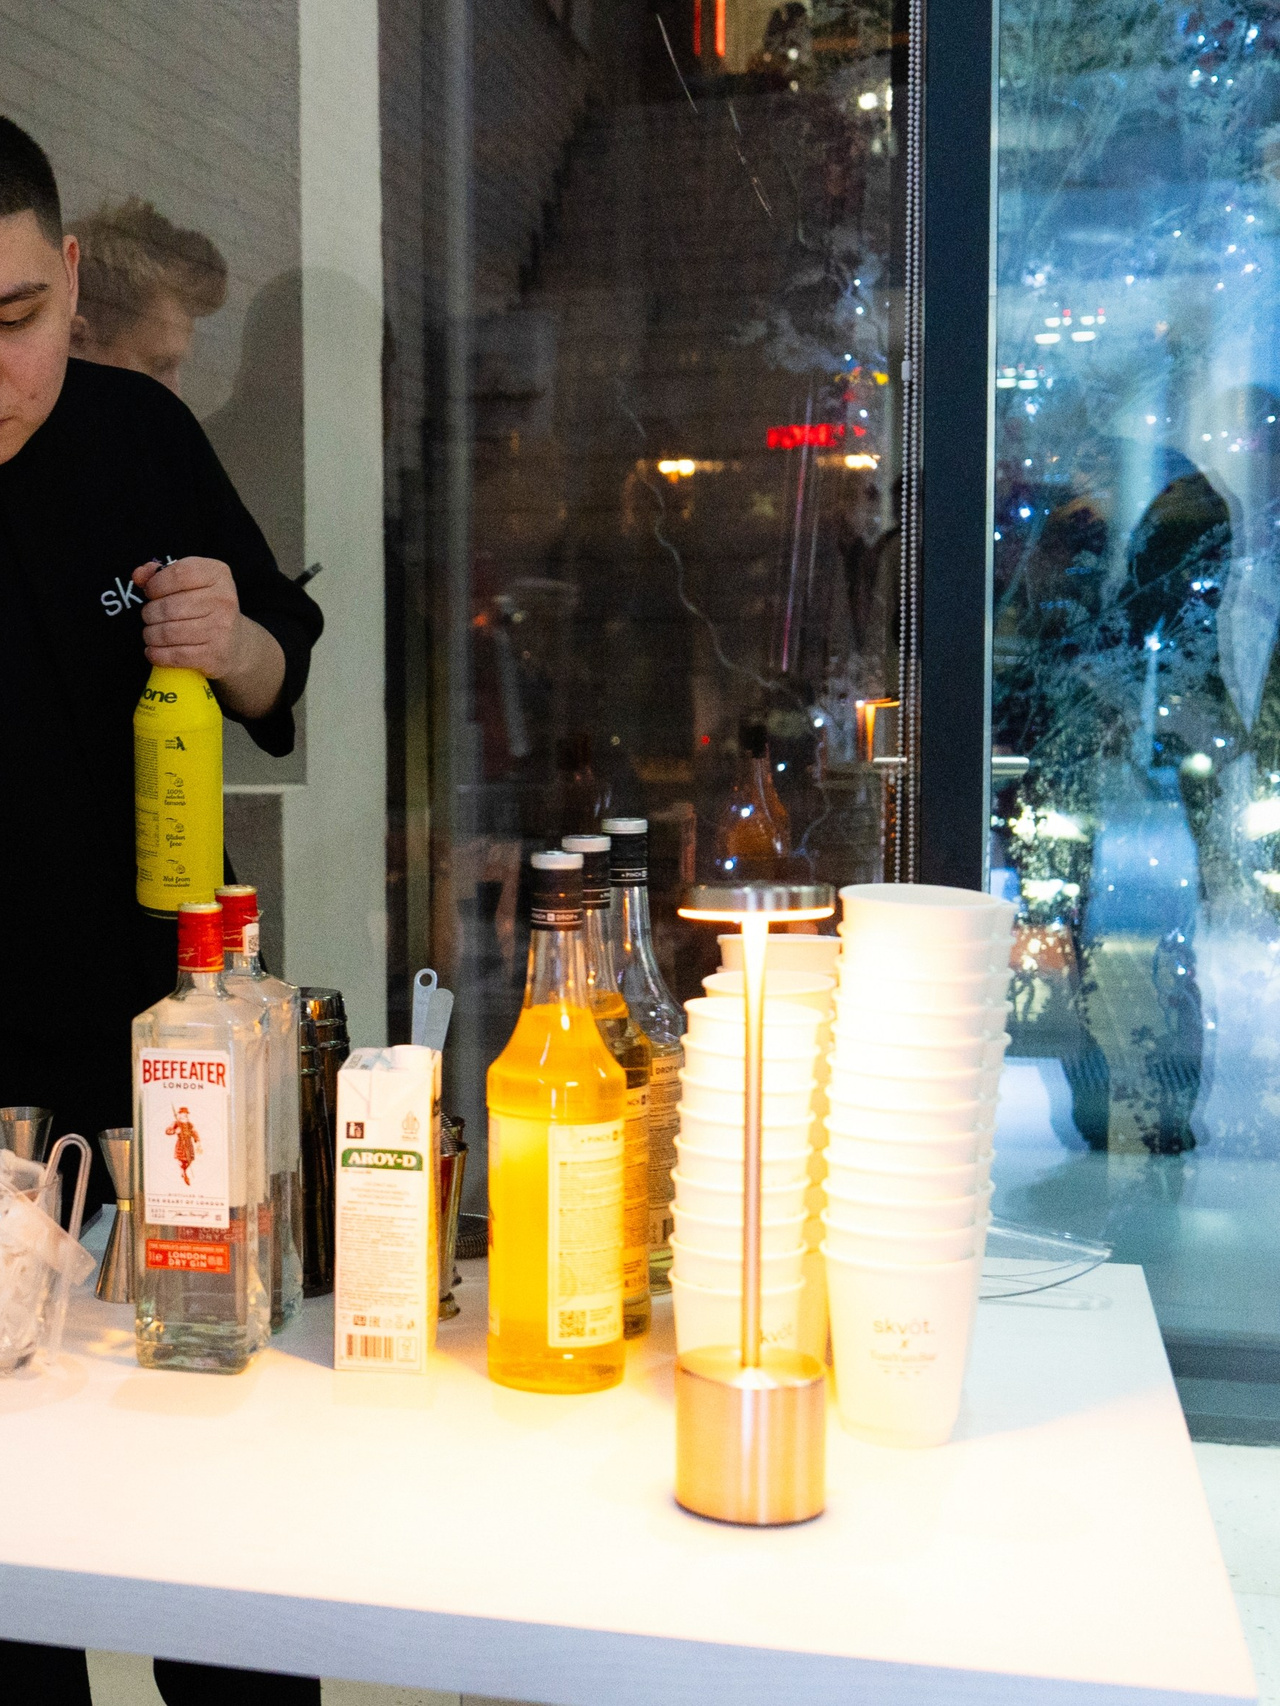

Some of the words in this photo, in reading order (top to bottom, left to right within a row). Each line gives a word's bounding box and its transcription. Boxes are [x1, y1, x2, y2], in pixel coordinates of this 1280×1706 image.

[141, 688, 177, 703] one
[142, 1058, 226, 1088] BEEFEATER
[162, 1081, 204, 1090] LONDON
[348, 1151, 417, 1168] AROY-D
[167, 1251, 207, 1261] LONDON
[167, 1258, 187, 1267] DRY
[189, 1260, 207, 1268] GIN
